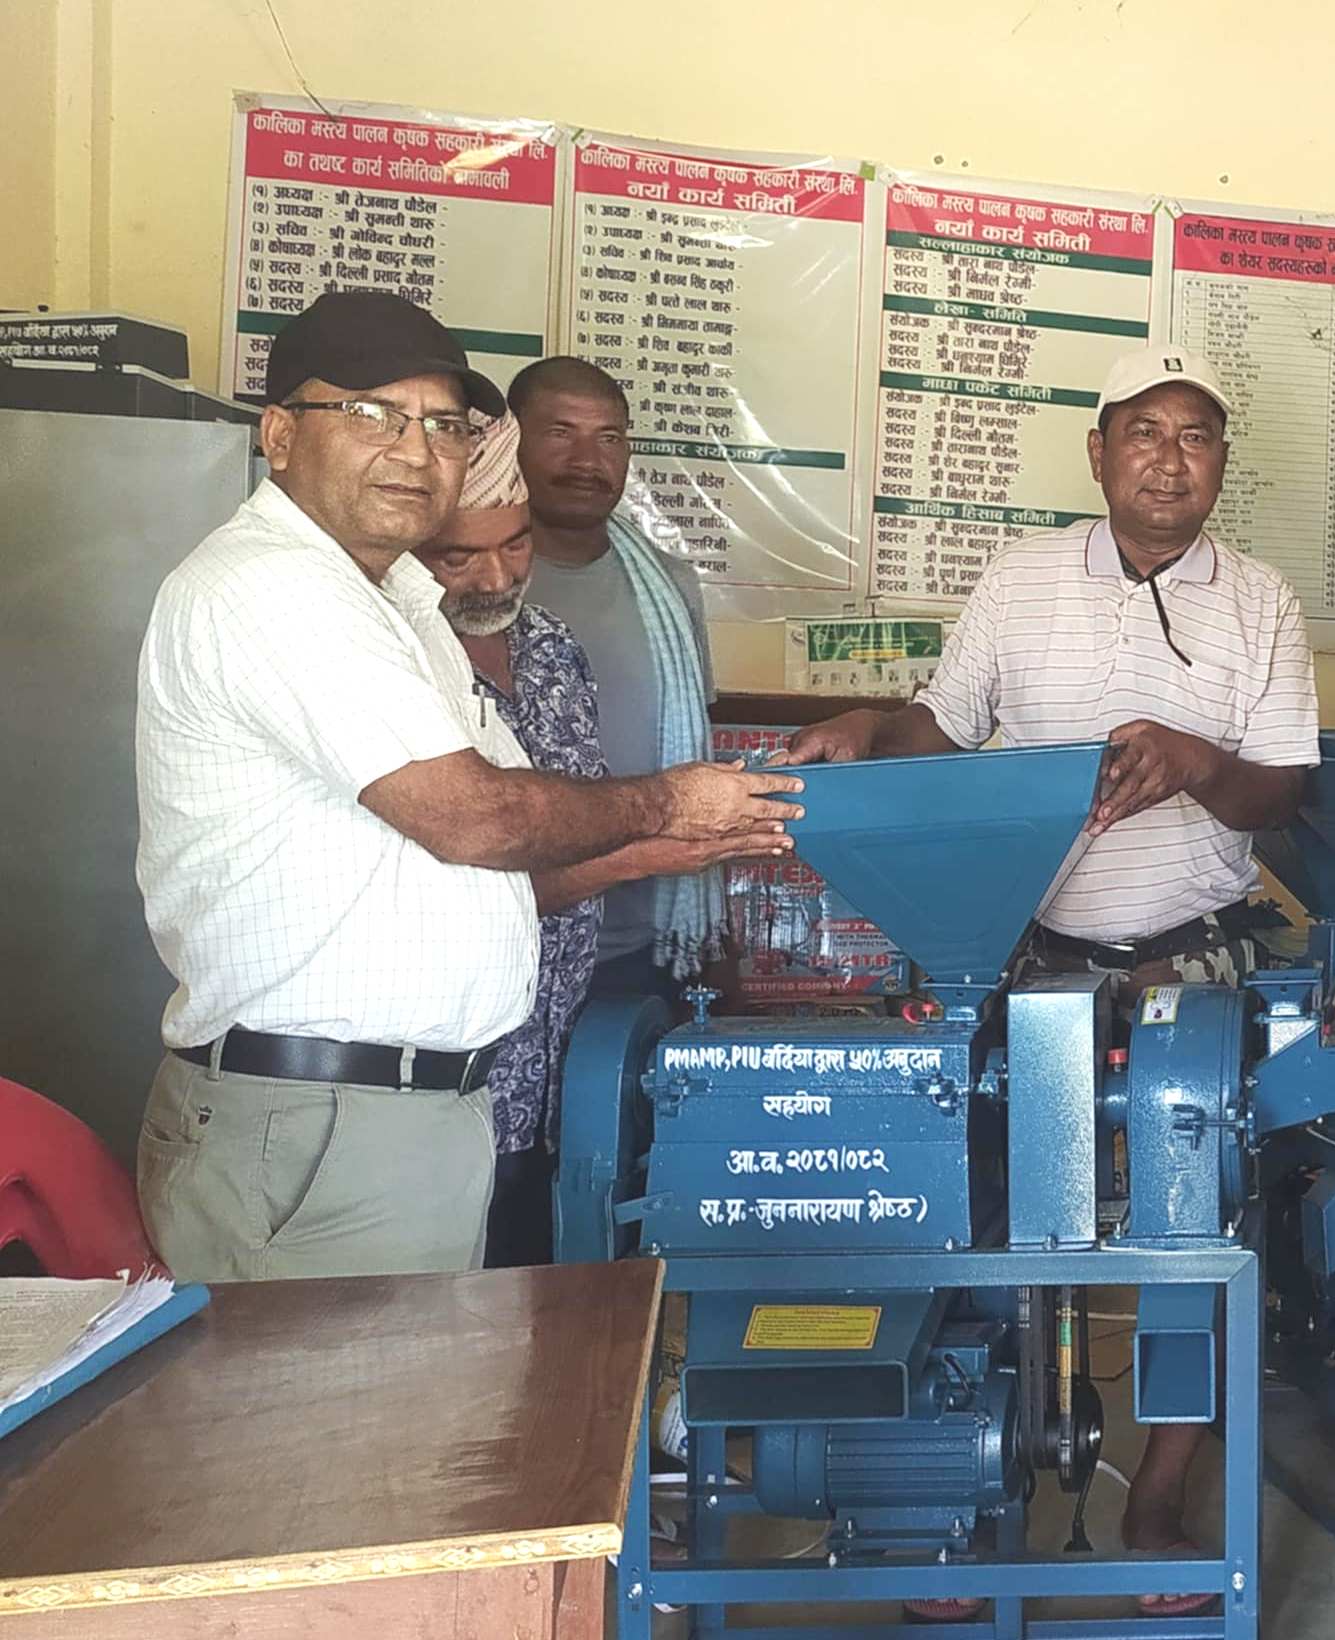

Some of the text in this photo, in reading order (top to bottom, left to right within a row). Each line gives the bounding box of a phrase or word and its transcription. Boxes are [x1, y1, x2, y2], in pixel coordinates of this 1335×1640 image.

[253, 112, 305, 135] कालिका
[353, 124, 388, 144] पालन
[393, 127, 430, 151] कृषक
[434, 130, 485, 154] सहकारी
[283, 150, 303, 169] का
[352, 153, 382, 178] कार्य
[580, 146, 630, 170] कालिका
[675, 160, 710, 179] पालन
[714, 166, 748, 187] कृषक
[752, 168, 800, 190] सहकारी
[627, 181, 670, 200] नयाँ
[679, 186, 725, 207] कार्य
[892, 188, 938, 209] कालिका
[979, 199, 1010, 218] पालन
[1015, 204, 1046, 224] कृषक
[1051, 206, 1094, 229] सहकारी
[934, 219, 1091, 252] नयाँ कार्य समिती
[1184, 219, 1224, 242] कालिका
[1262, 230, 1290, 248] पालन
[883, 1048, 942, 1076] अनुदान
[763, 1089, 831, 1120] सहयोग
